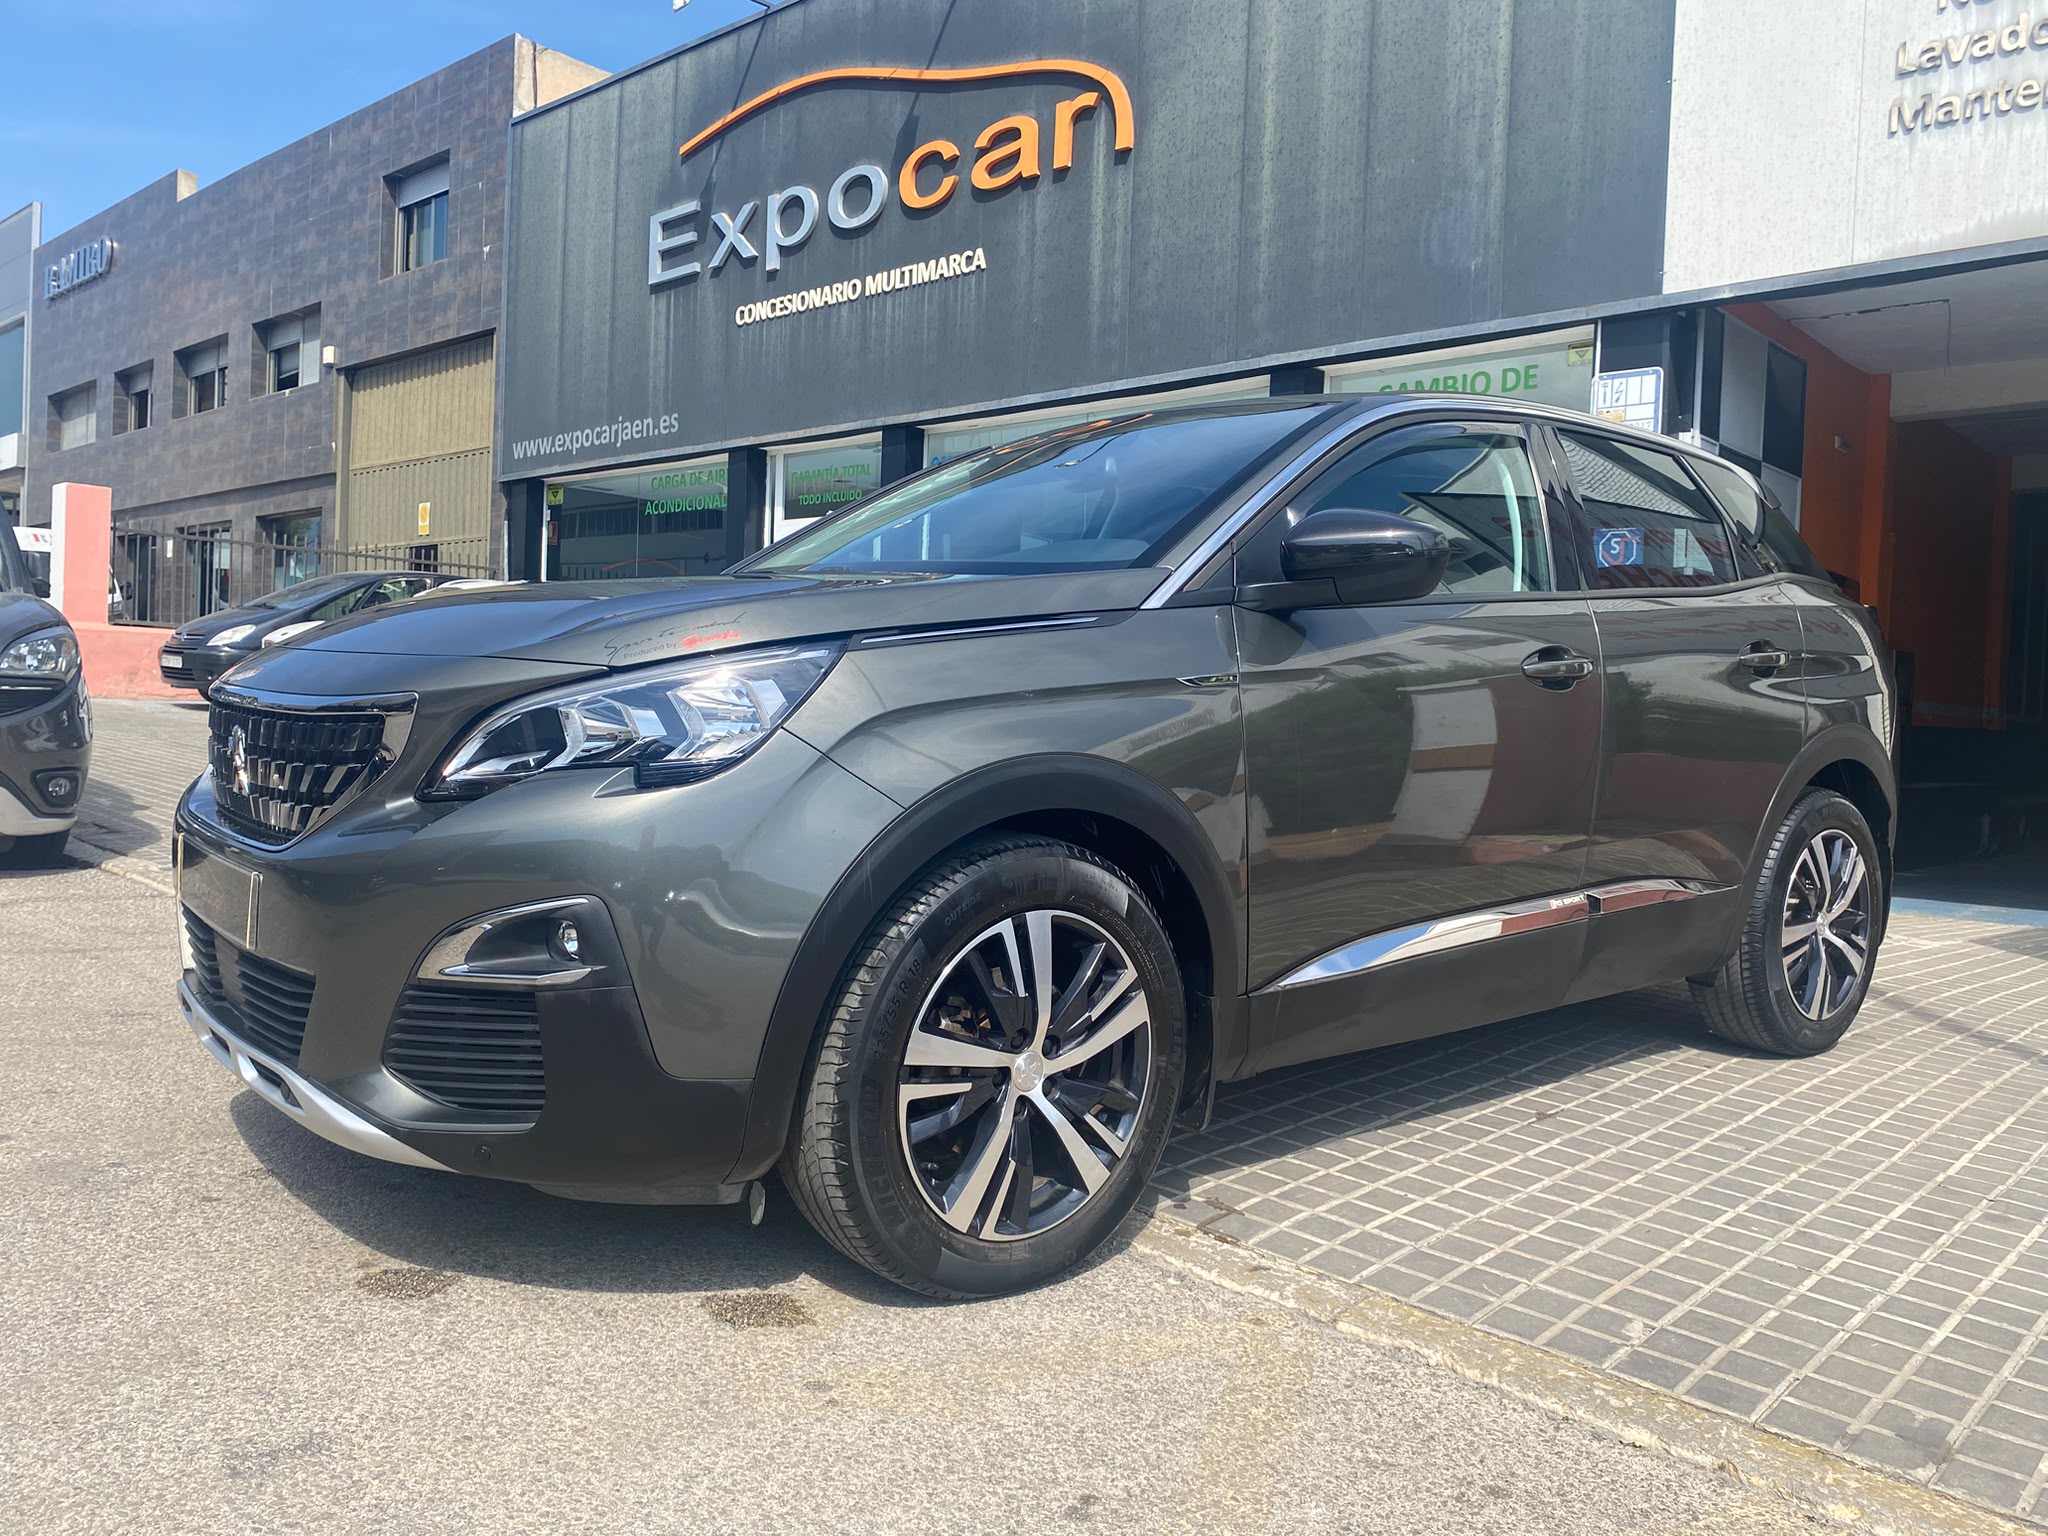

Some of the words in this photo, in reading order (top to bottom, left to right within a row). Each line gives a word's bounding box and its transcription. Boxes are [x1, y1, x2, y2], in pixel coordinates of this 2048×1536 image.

[1889, 79, 2048, 135] Mante
[735, 278, 862, 326] CONCESIONARIO
[865, 247, 987, 297] MULTIMARCA
[1501, 364, 1539, 393] DE
[512, 412, 679, 460] www.expocarjaen.es
[650, 473, 687, 491] CARGA
[791, 464, 840, 484] GARANTÍA
[842, 464, 872, 479] TOTAL
[799, 494, 821, 505] TODO
[822, 489, 863, 503] INCLUIDO
[624, 644, 665, 659] Produced
[666, 641, 677, 649] by
